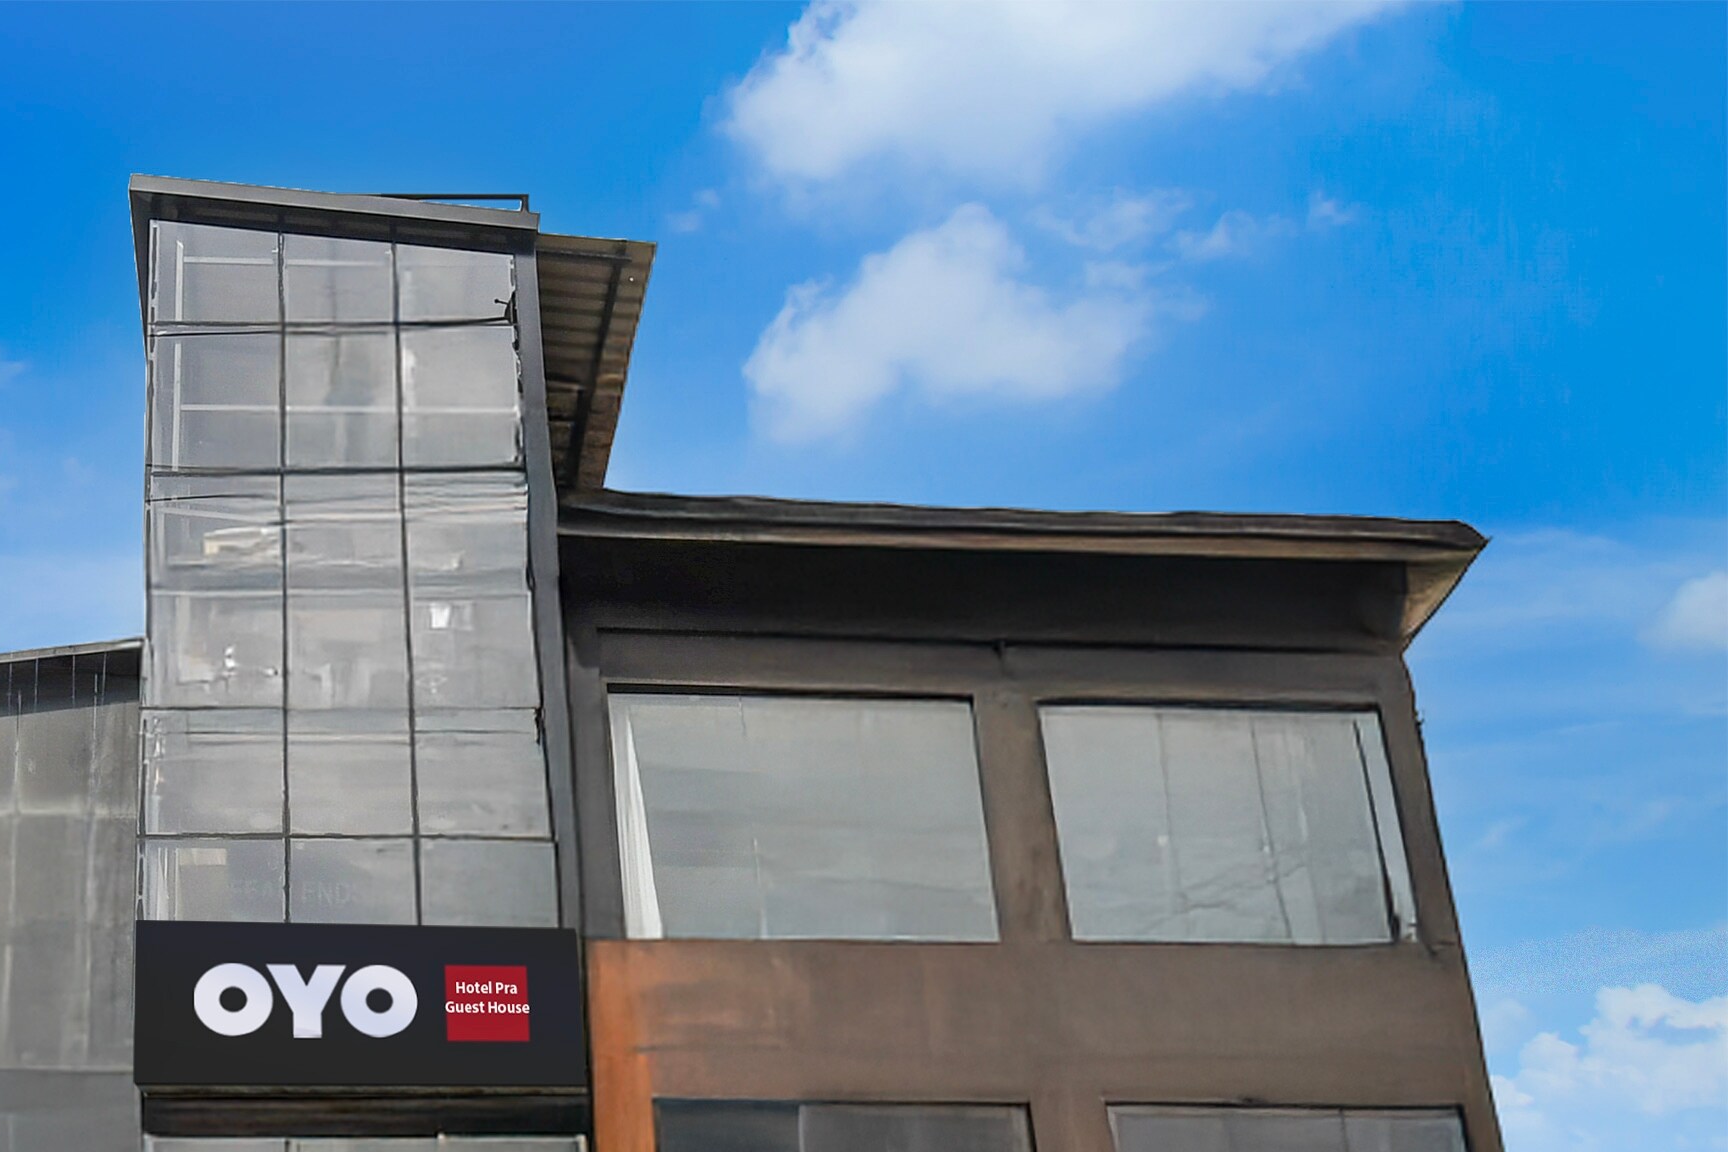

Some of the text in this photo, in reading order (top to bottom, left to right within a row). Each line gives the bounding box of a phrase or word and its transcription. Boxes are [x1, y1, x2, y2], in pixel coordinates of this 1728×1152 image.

[455, 980, 518, 995] Hotel Pra
[193, 962, 418, 1039] OYO
[445, 1001, 530, 1014] Guest House
